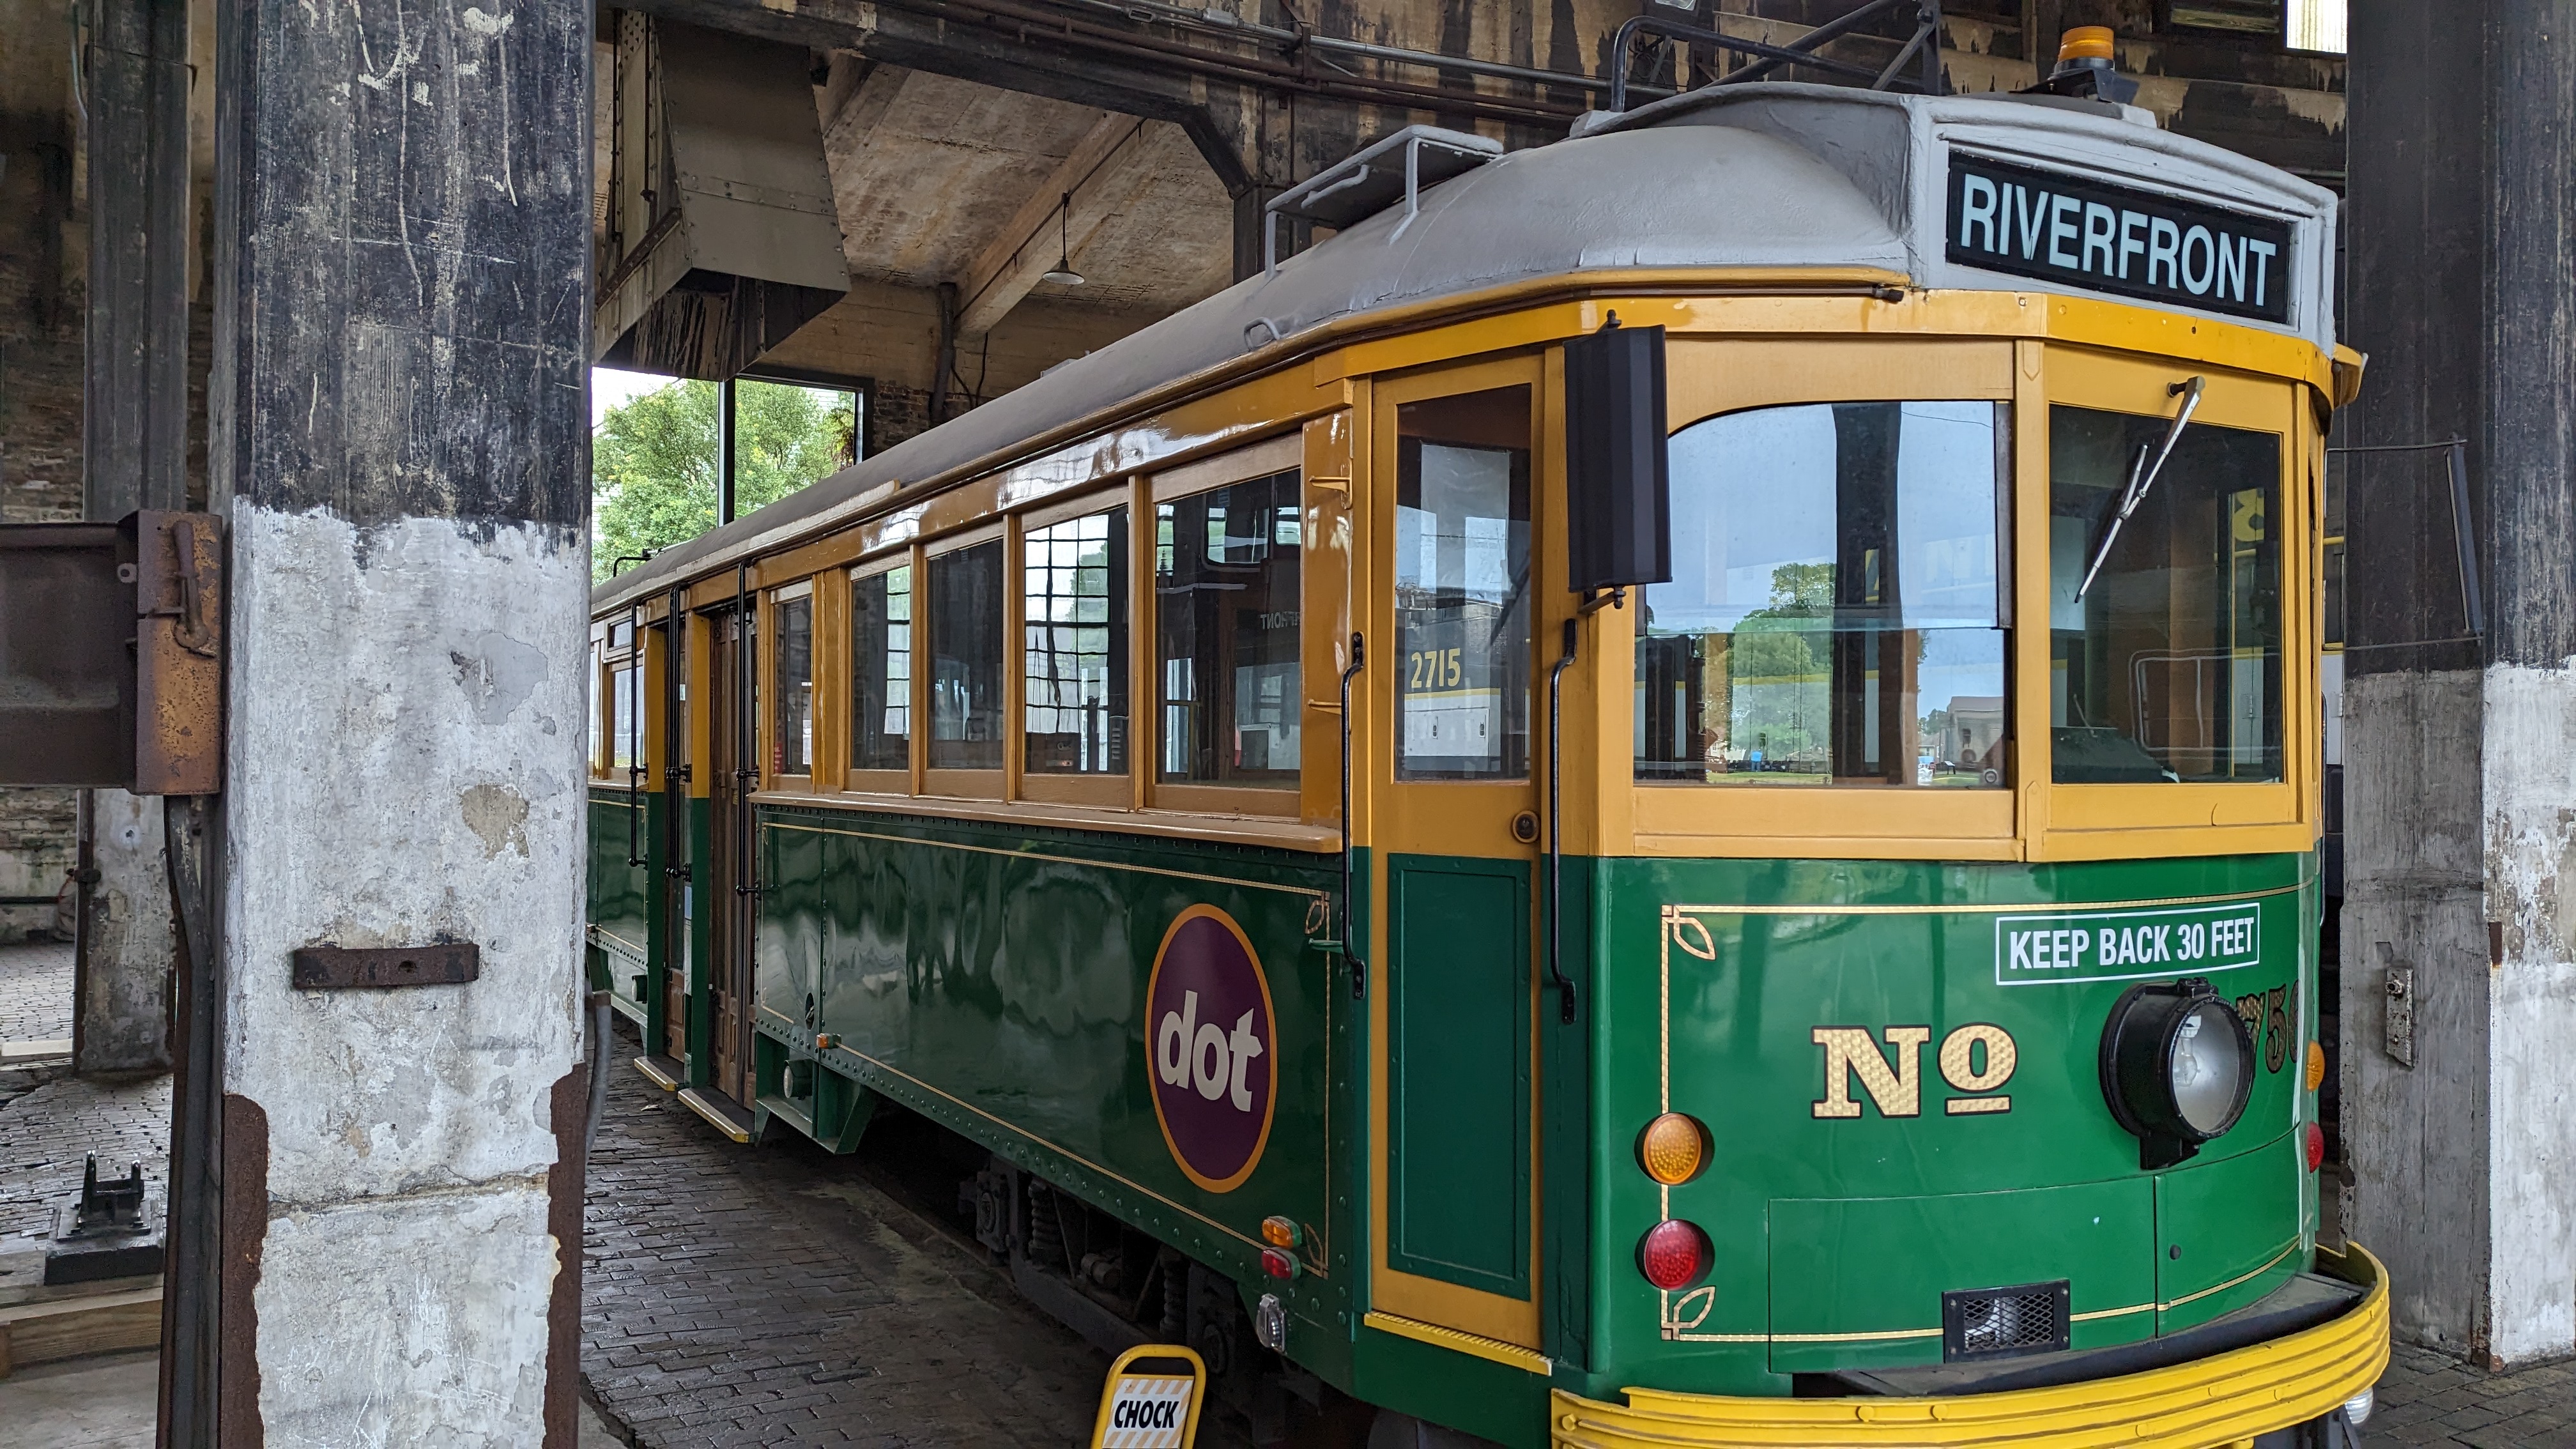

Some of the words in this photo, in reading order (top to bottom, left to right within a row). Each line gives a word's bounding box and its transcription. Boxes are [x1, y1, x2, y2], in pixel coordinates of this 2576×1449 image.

[1961, 173, 2277, 306] RIVERFRONT
[1411, 648, 1461, 688] 2715
[2009, 930, 2090, 969] KEEP
[2099, 924, 2171, 965] BACK
[2177, 923, 2205, 961] 30
[2211, 917, 2255, 957] FEET
[1158, 990, 1264, 1112] dot
[1114, 1399, 1179, 1429] CHOCK
